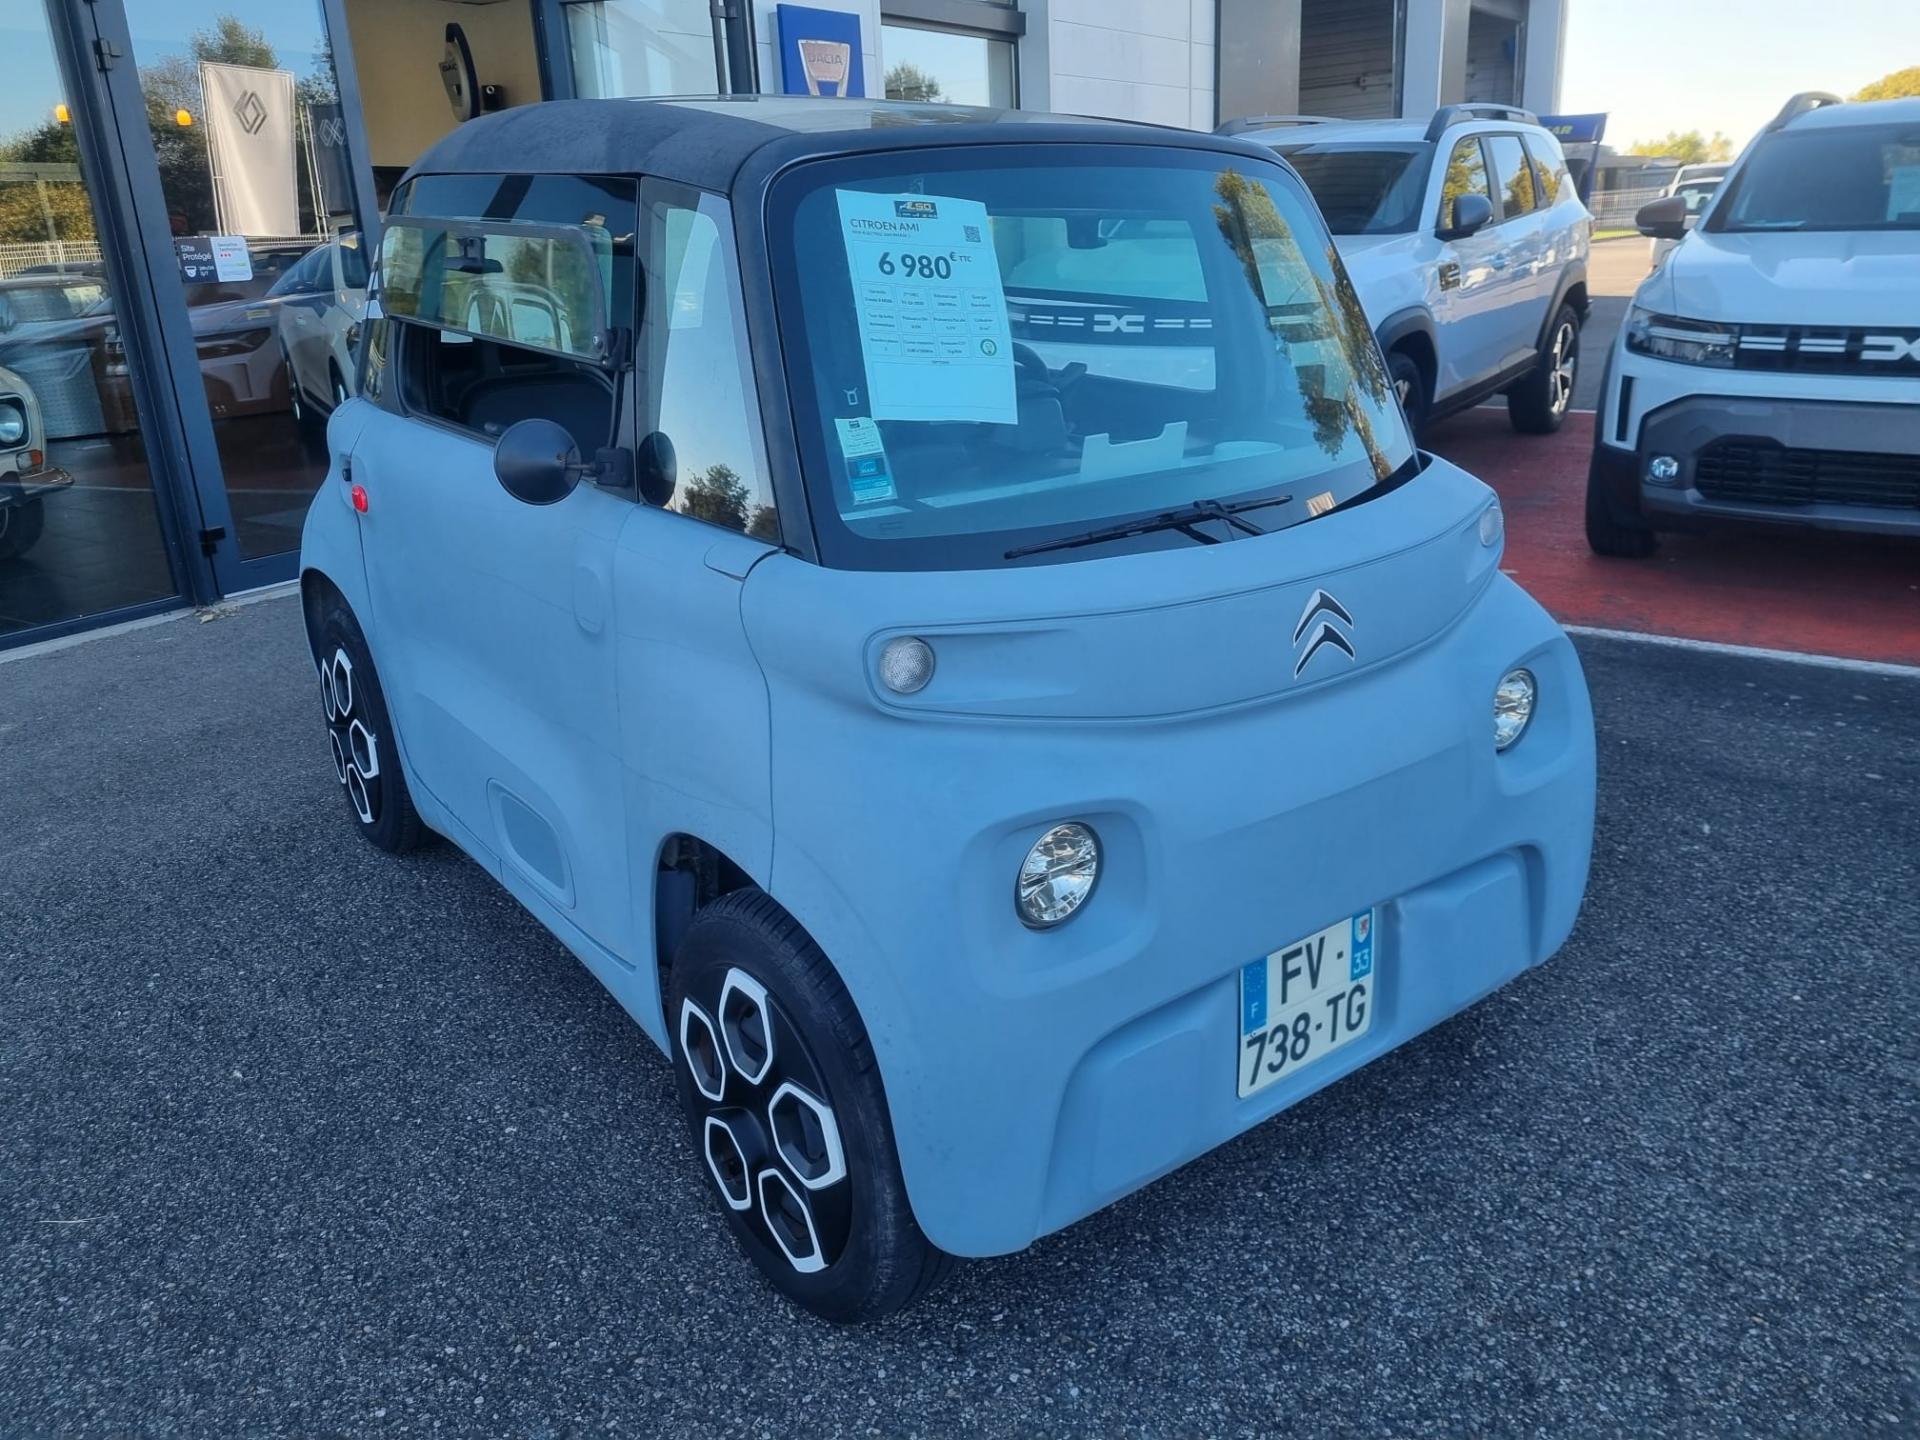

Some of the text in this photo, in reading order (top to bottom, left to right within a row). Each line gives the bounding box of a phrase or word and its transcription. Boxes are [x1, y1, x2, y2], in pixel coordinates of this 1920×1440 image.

[850, 218, 920, 232] CITROEN AMI
[183, 252, 212, 261] Protégé
[878, 252, 896, 276] 6
[1353, 948, 1369, 973] 33
[1251, 1002, 1259, 1019] F
